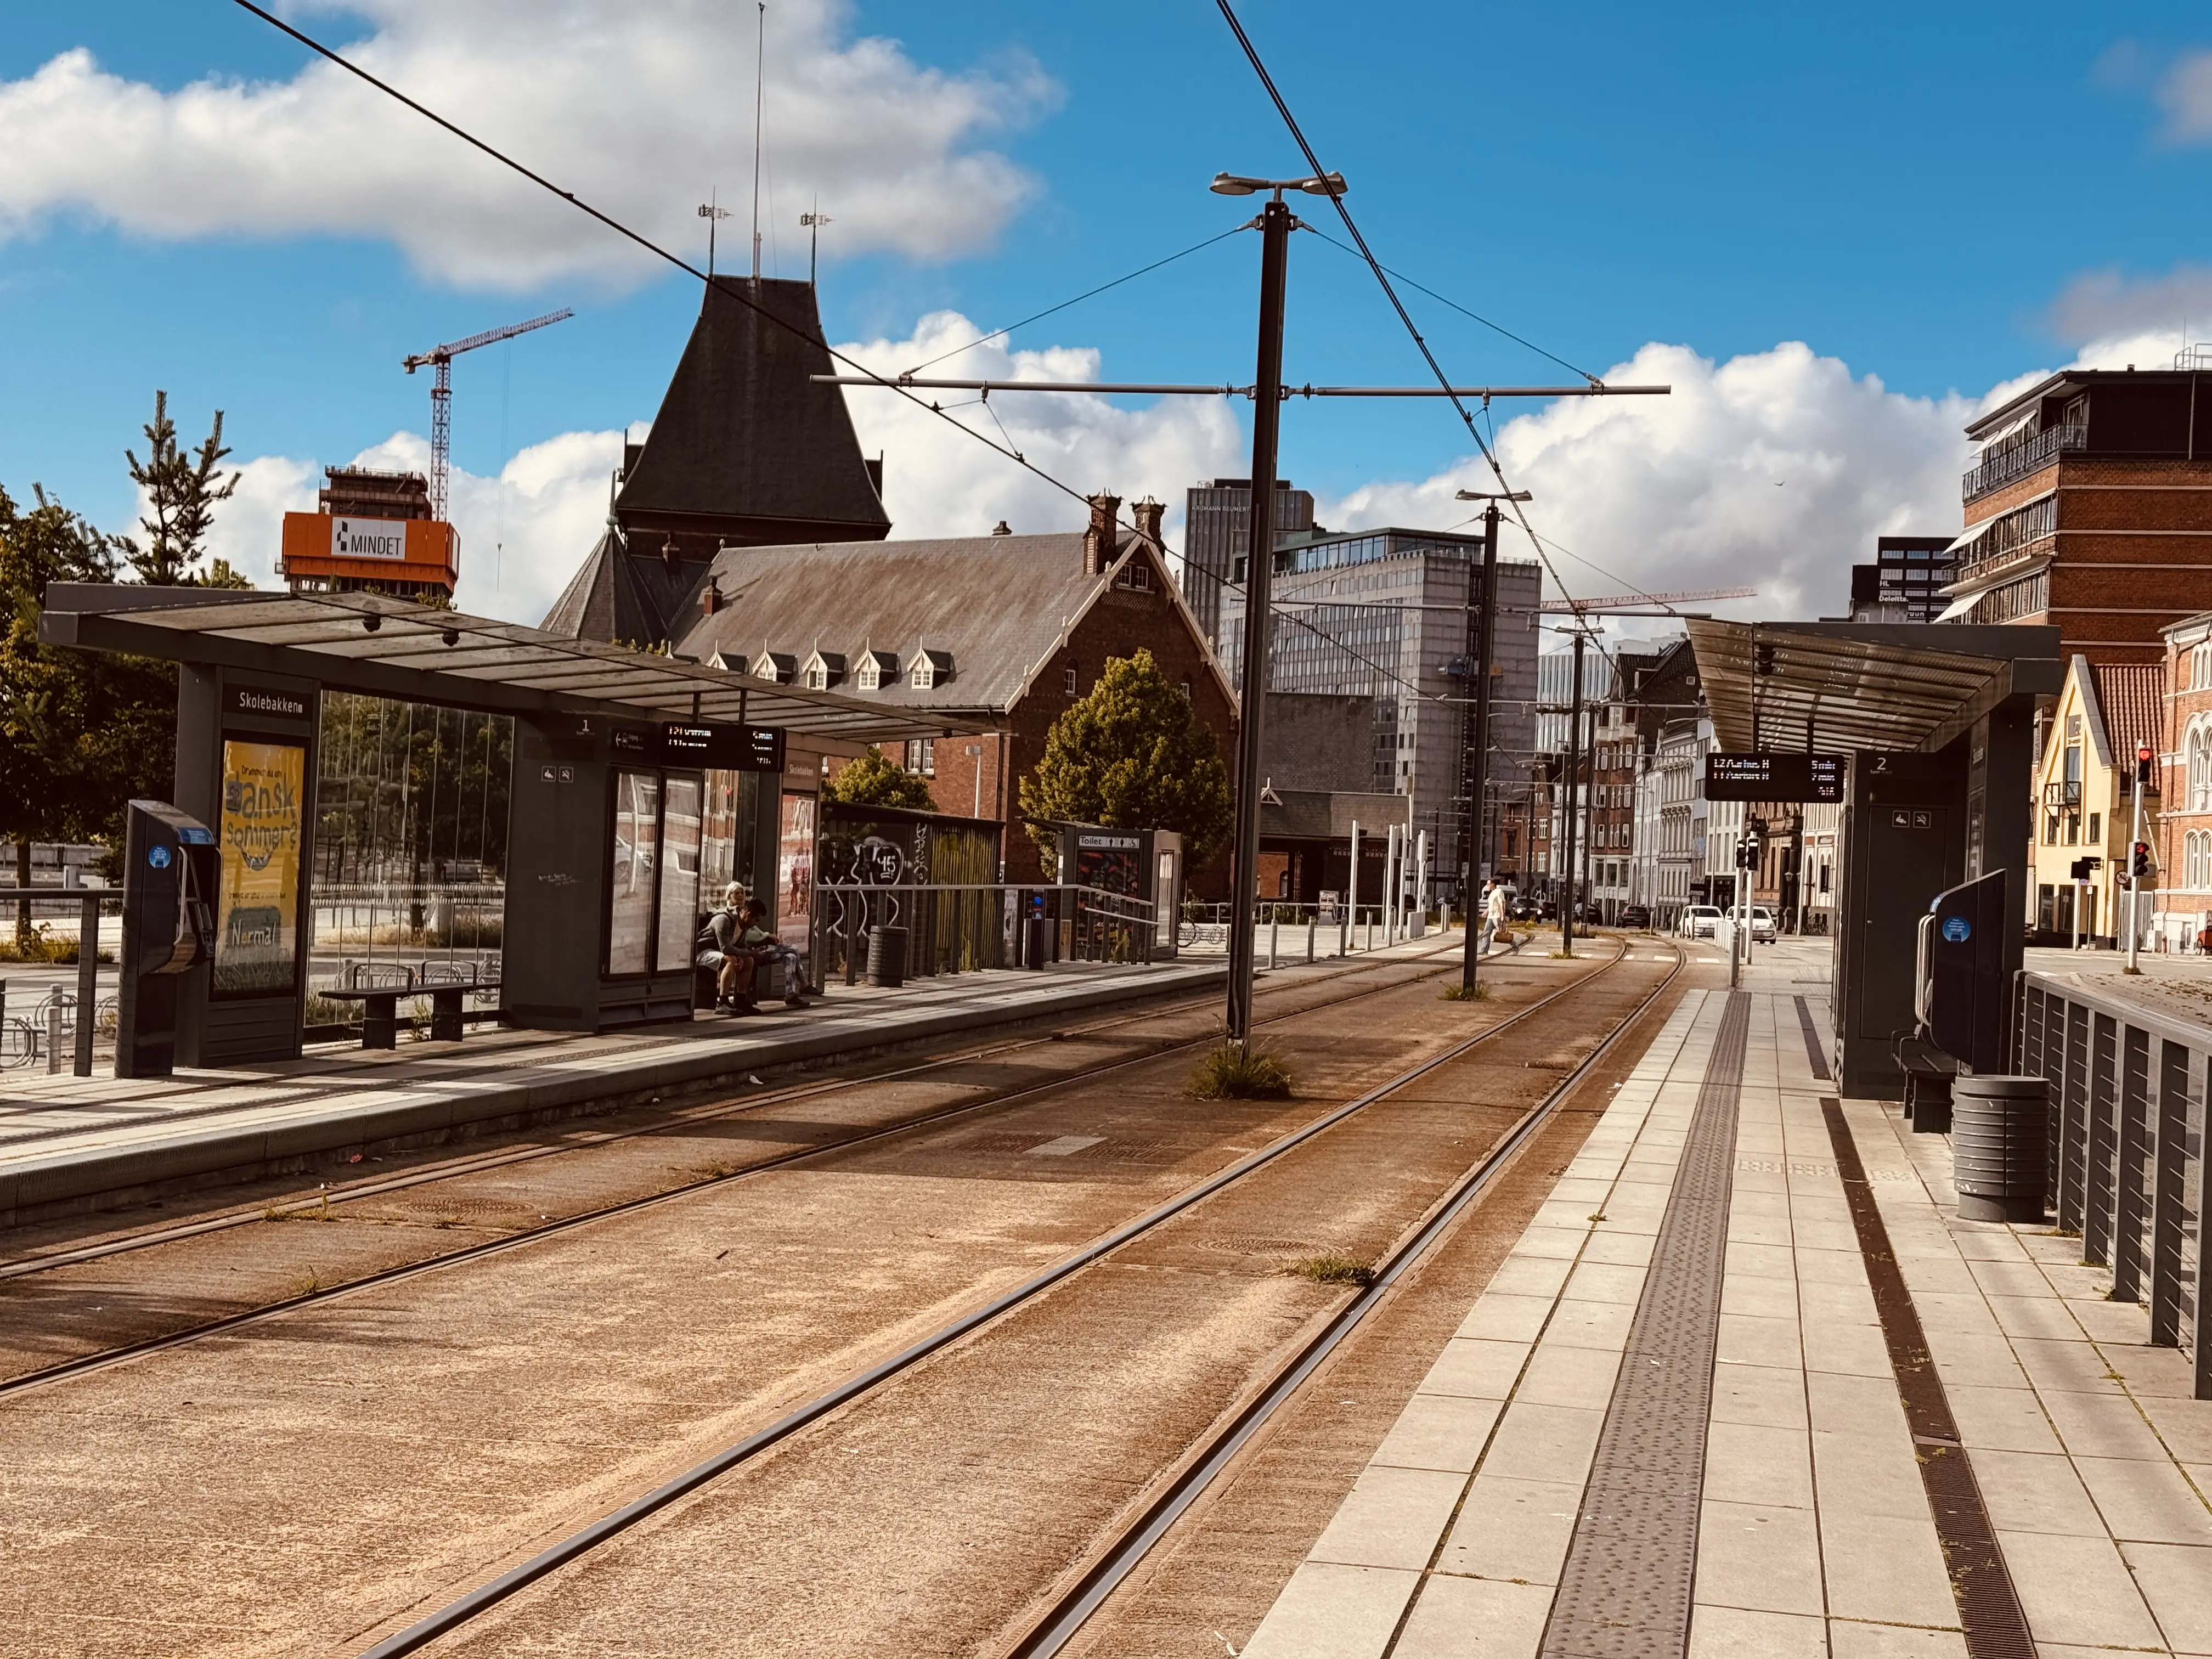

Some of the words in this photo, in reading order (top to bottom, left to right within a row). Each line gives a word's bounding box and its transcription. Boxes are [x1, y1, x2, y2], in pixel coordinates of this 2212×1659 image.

[351, 535, 402, 555] MINDET
[239, 692, 298, 713] Skolebakken
[582, 720, 590, 731] 1
[1877, 757, 1886, 770] 2
[1080, 836, 1103, 845] Toilet
[232, 918, 276, 947] Normal
